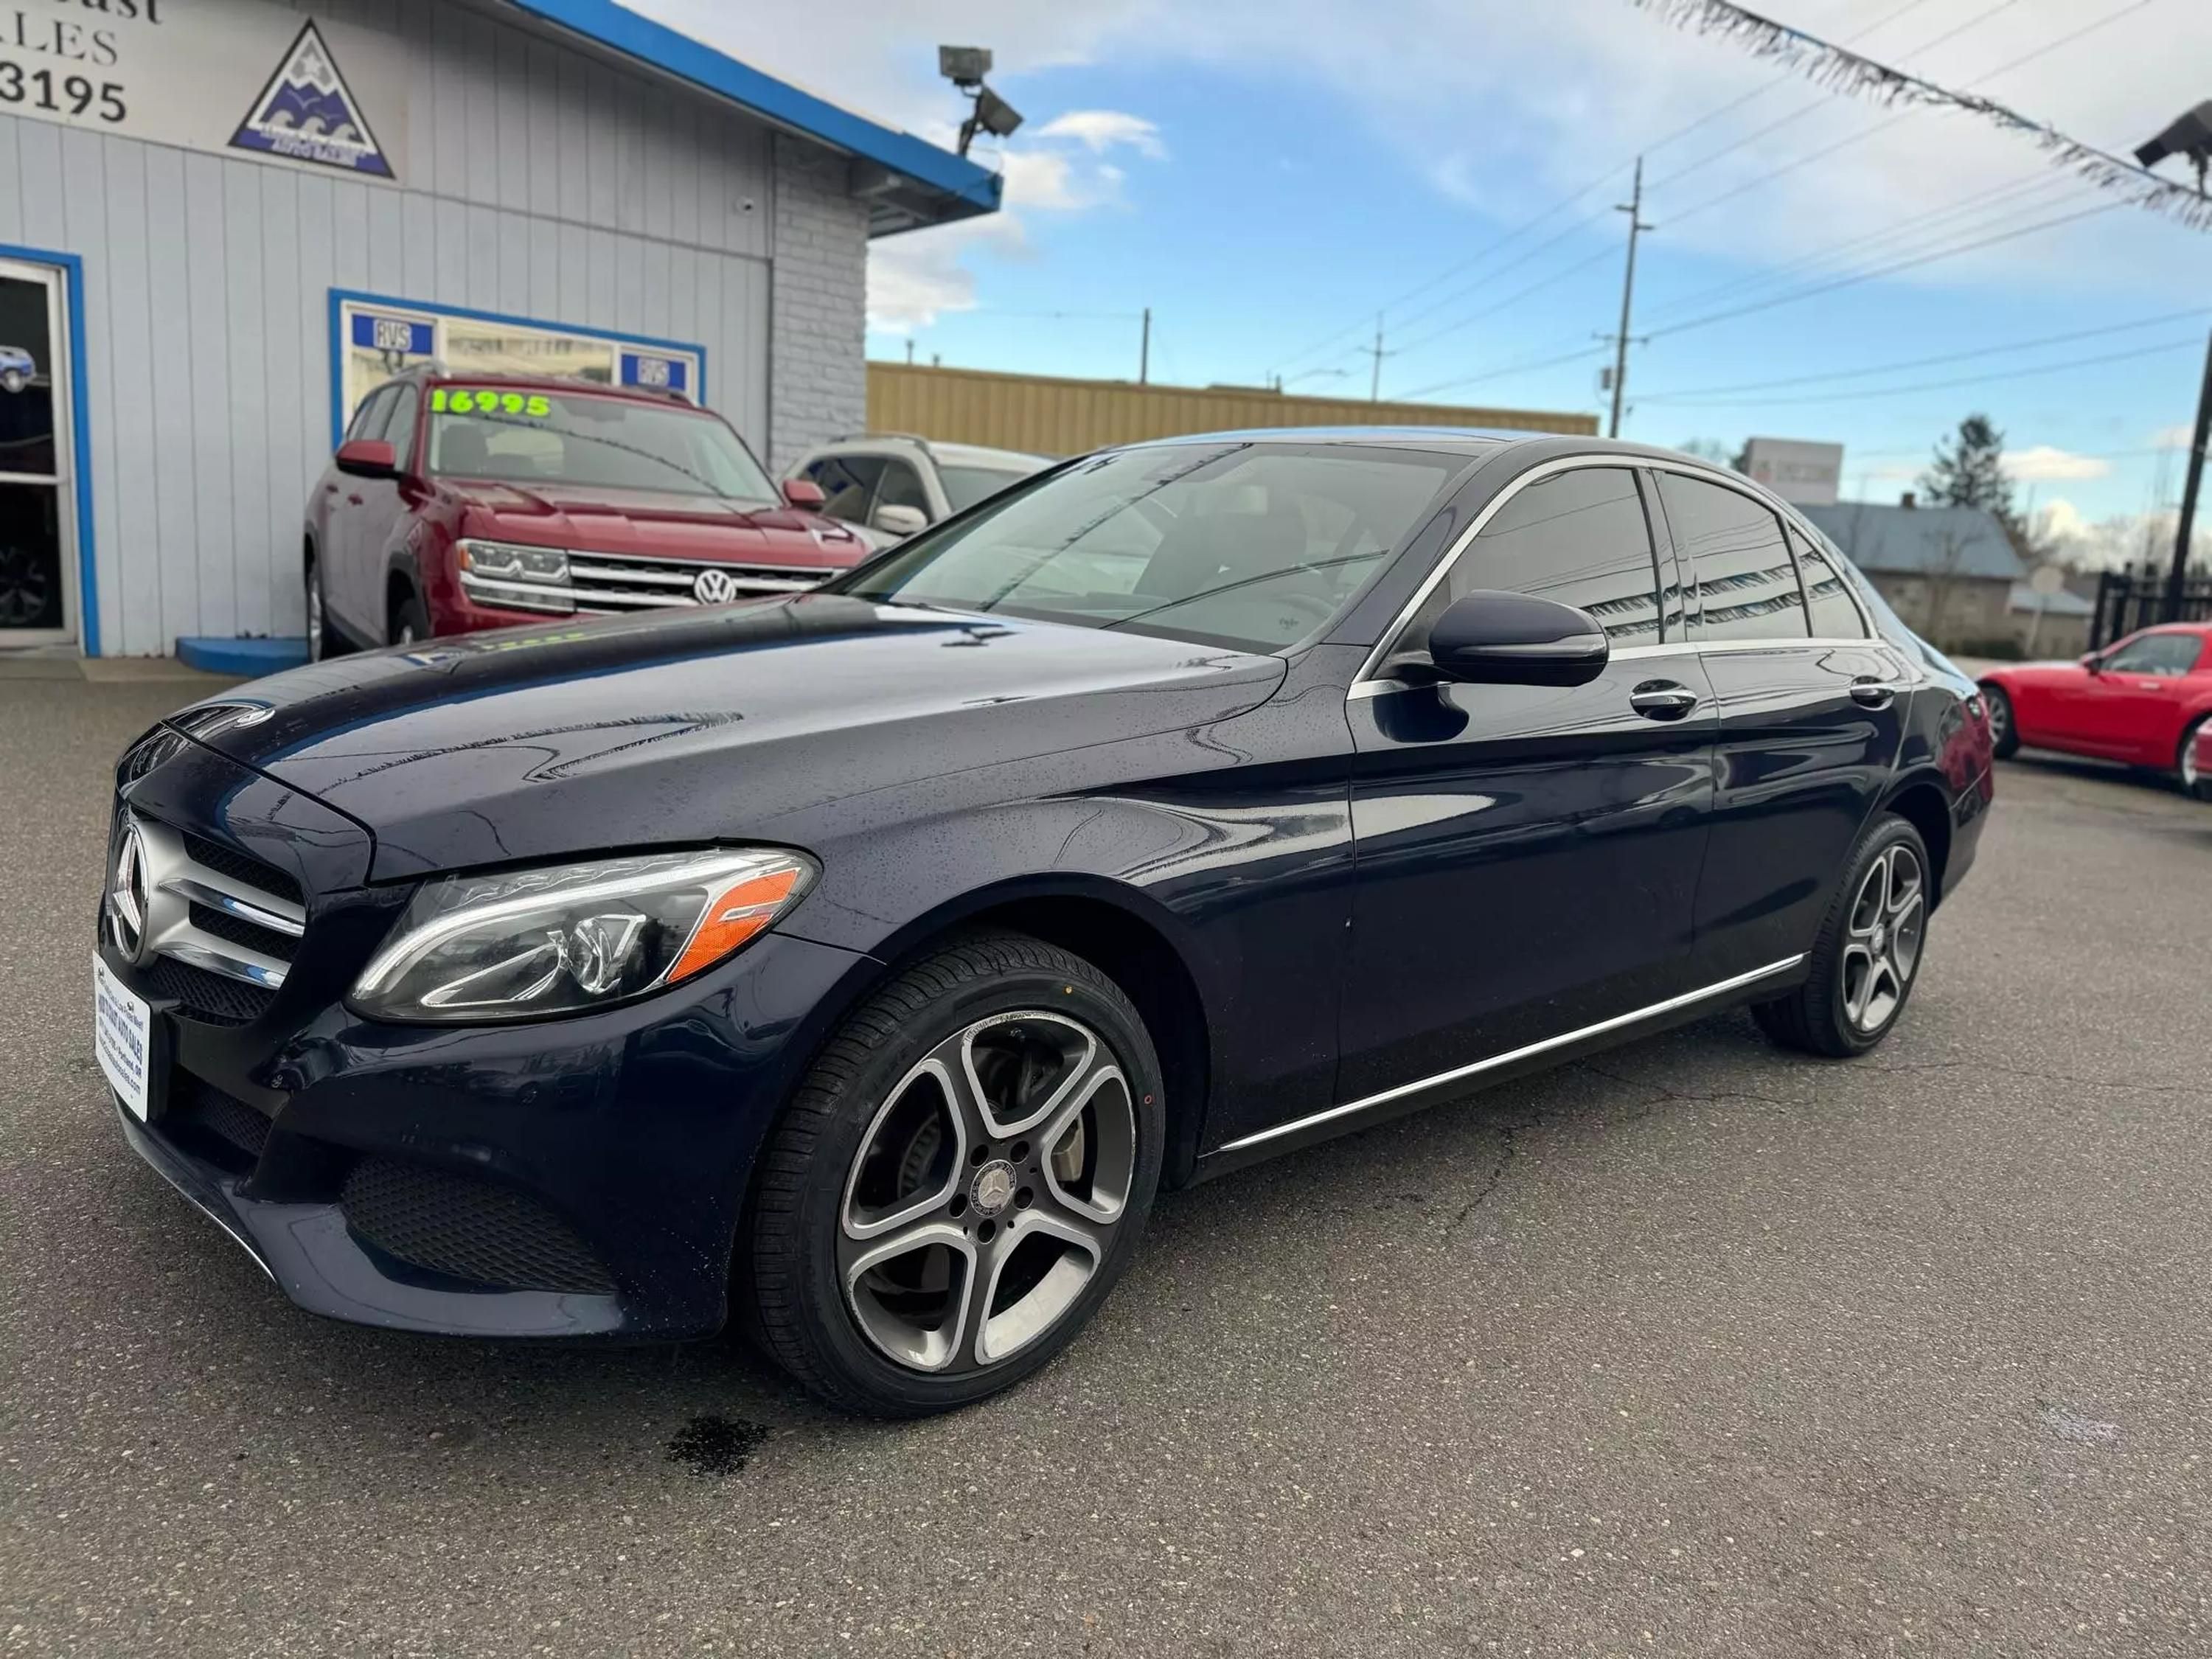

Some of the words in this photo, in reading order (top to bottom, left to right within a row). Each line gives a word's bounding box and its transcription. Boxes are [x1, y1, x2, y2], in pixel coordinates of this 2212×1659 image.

[0, 10, 118, 66] LES
[432, 389, 550, 417] 16995
[129, 1028, 142, 1066] SALES
